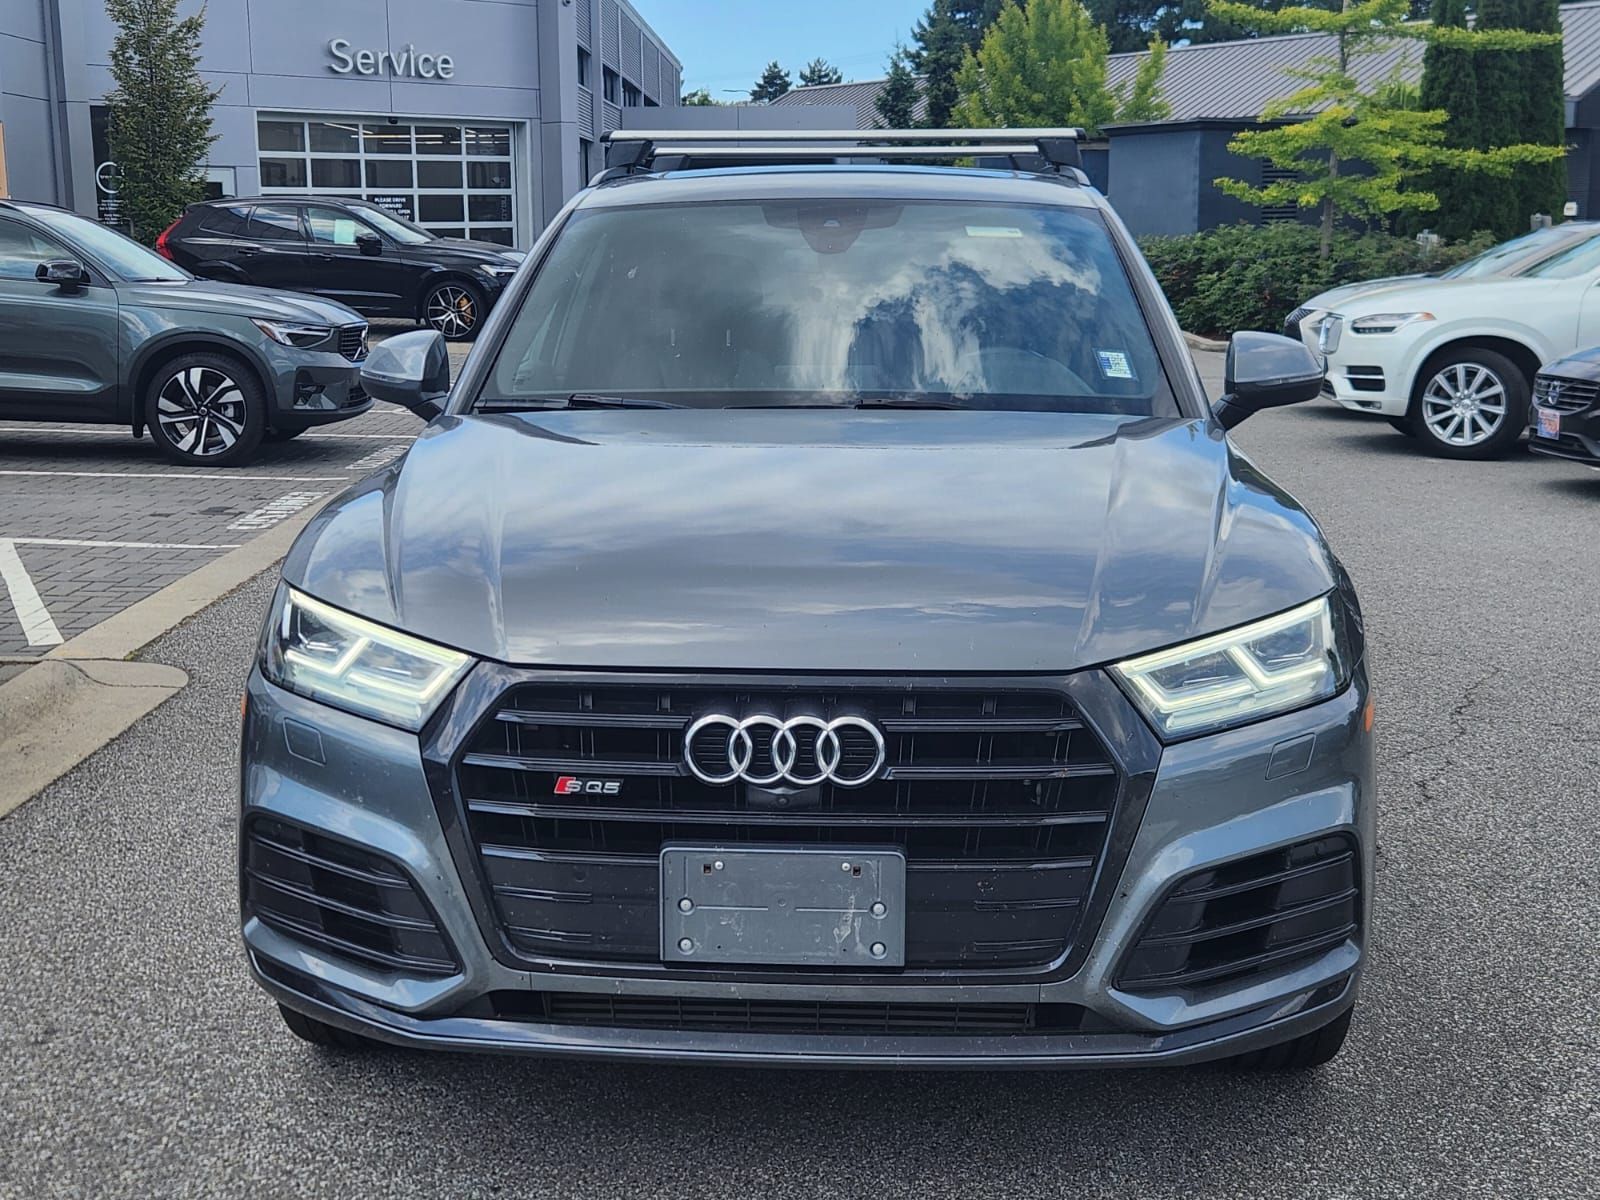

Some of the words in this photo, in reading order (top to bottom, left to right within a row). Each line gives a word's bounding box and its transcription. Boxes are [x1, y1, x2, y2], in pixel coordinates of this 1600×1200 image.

[328, 38, 454, 79] Service
[226, 490, 330, 530] CUSTOMER
[562, 779, 620, 794] SQ5
